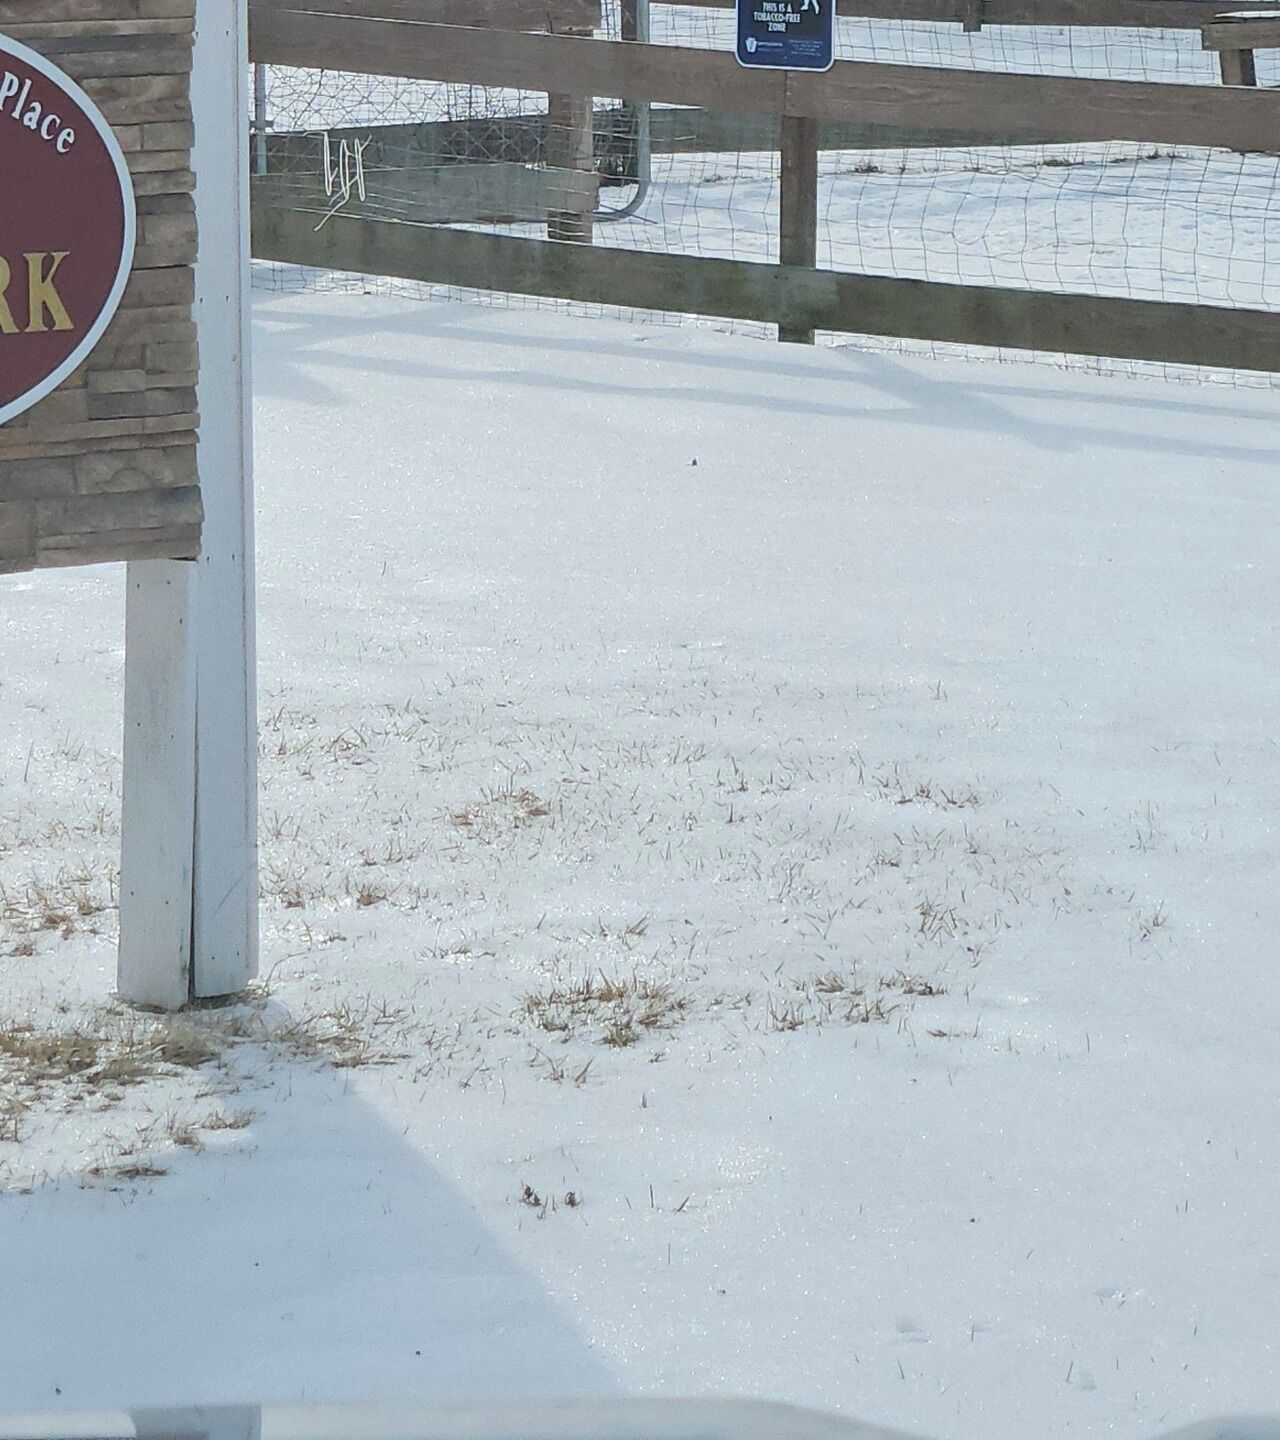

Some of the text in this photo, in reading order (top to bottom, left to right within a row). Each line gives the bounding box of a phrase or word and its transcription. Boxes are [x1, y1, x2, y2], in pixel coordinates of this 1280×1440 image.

[762, 2, 792, 13] THIS IS A
[753, 11, 801, 23] TOBACCO-FREE
[768, 22, 787, 33] ZONE
